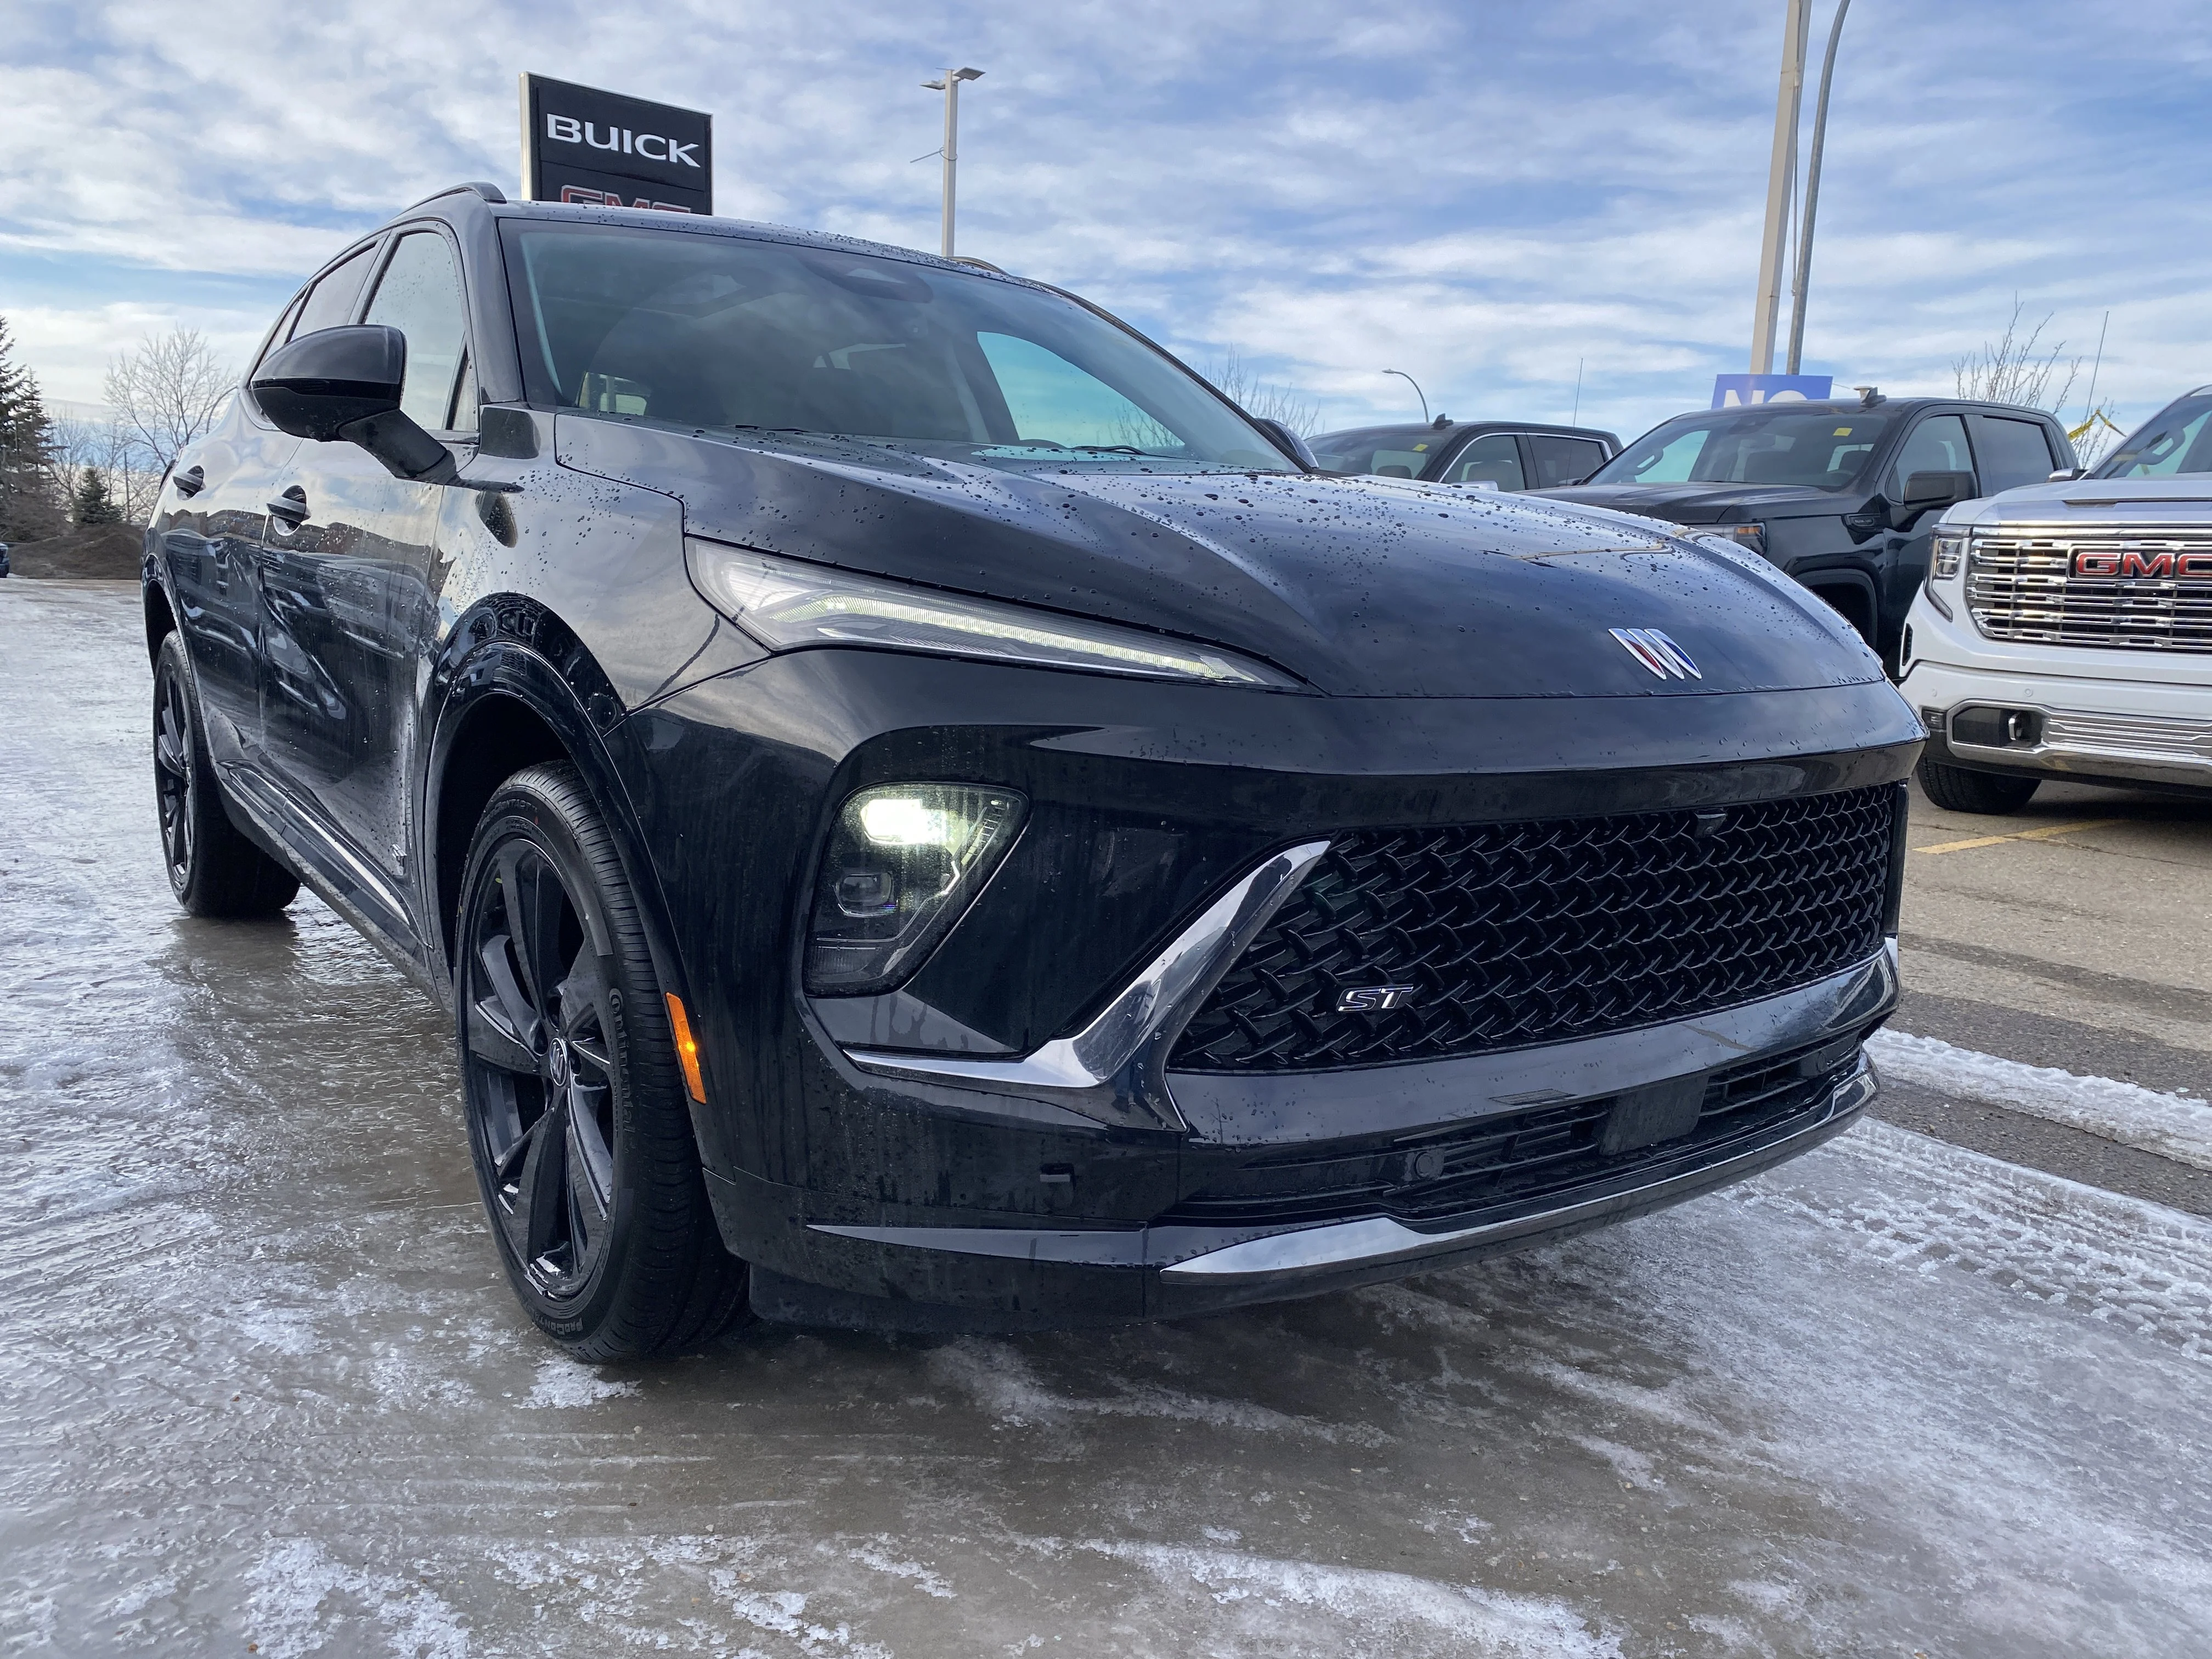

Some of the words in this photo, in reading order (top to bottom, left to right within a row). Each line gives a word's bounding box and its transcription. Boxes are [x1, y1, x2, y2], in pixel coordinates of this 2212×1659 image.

[547, 113, 701, 168] BUICK
[2076, 551, 2212, 578] GMC
[1338, 986, 1414, 1012] ST
